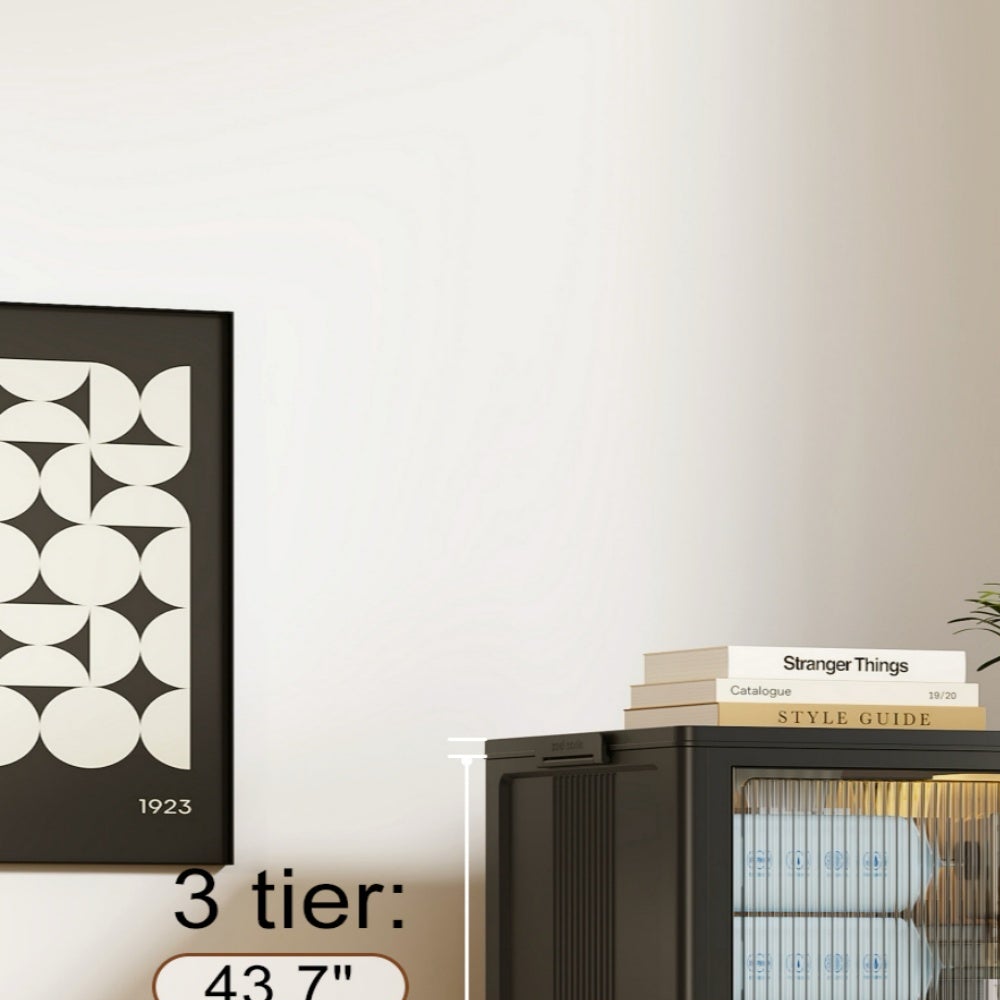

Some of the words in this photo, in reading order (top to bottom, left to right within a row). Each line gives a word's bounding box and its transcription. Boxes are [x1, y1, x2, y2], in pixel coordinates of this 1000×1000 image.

[783, 655, 852, 675] Stranger
[854, 656, 909, 676] Things
[730, 685, 792, 698] Catalogue
[929, 691, 957, 700] 19/20
[777, 710, 848, 725] STYLE
[859, 711, 931, 726] GUIDE
[139, 798, 192, 815] 1923
